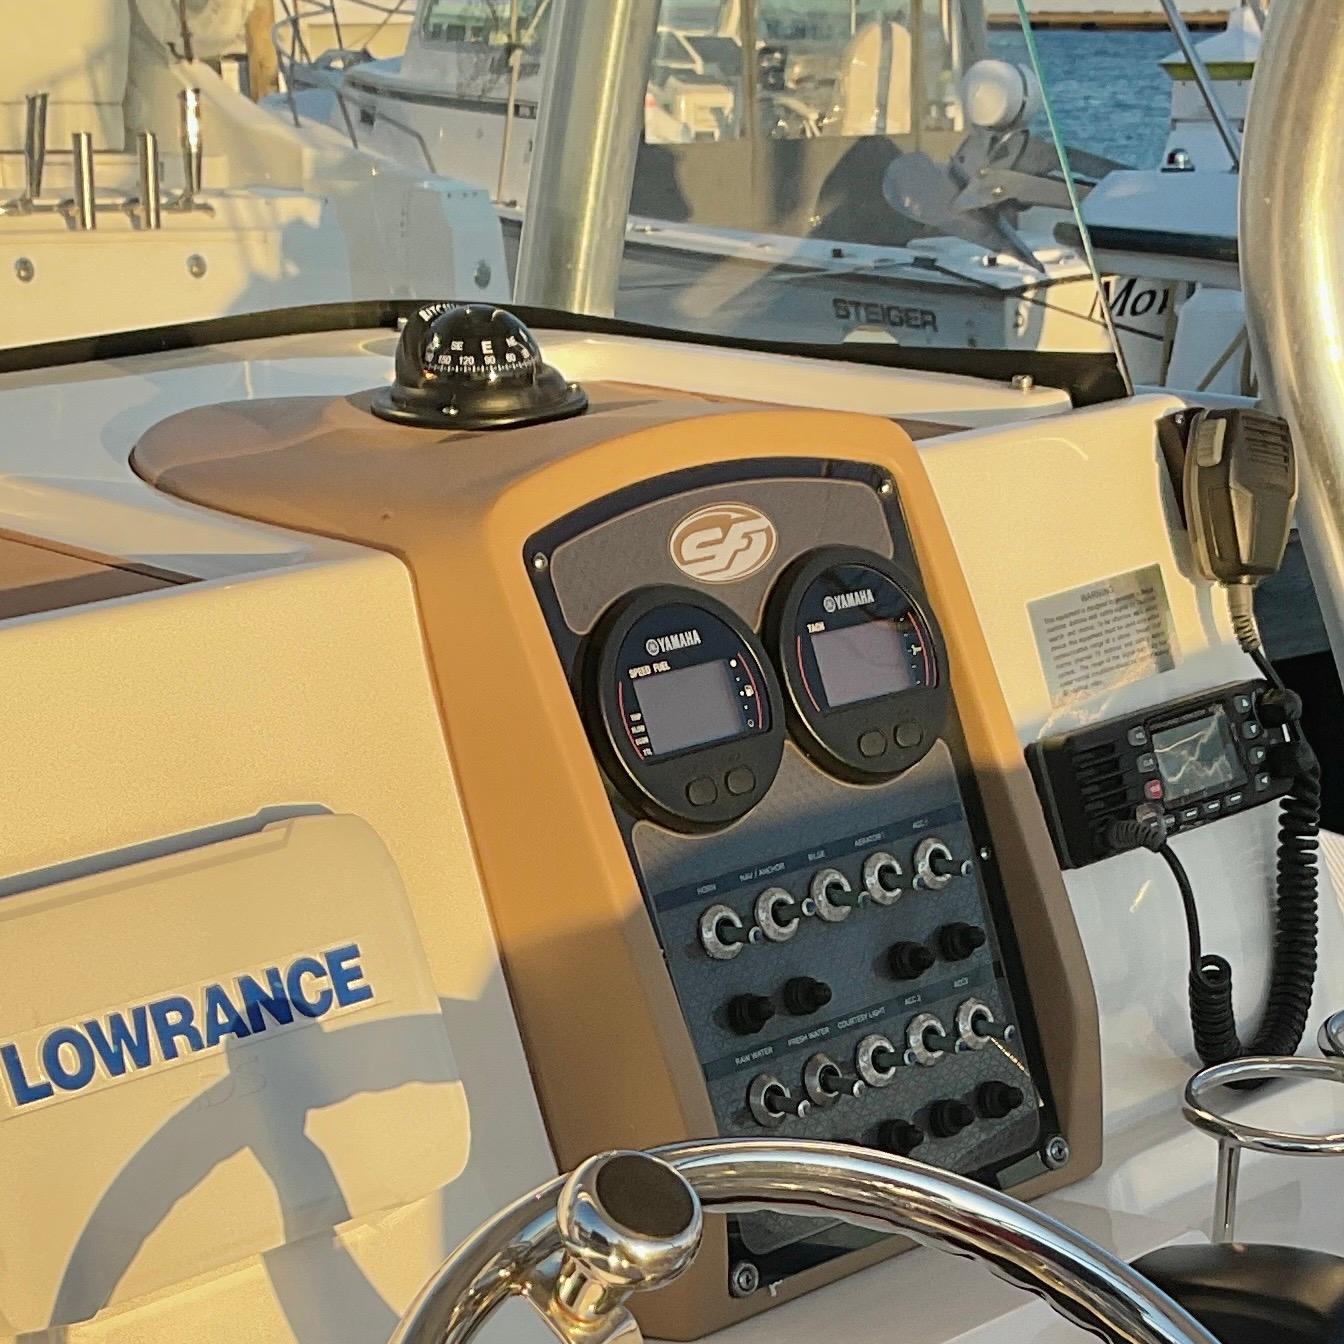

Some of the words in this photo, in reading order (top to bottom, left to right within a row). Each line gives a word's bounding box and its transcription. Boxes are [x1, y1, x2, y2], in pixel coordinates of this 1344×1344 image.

[832, 298, 938, 332] STEIGER
[481, 340, 494, 354] E
[459, 355, 475, 366] 120
[834, 589, 875, 610] YAMAHA
[657, 629, 702, 652] YAMAHA
[628, 665, 651, 679] SPEED
[653, 661, 671, 673] FUEL
